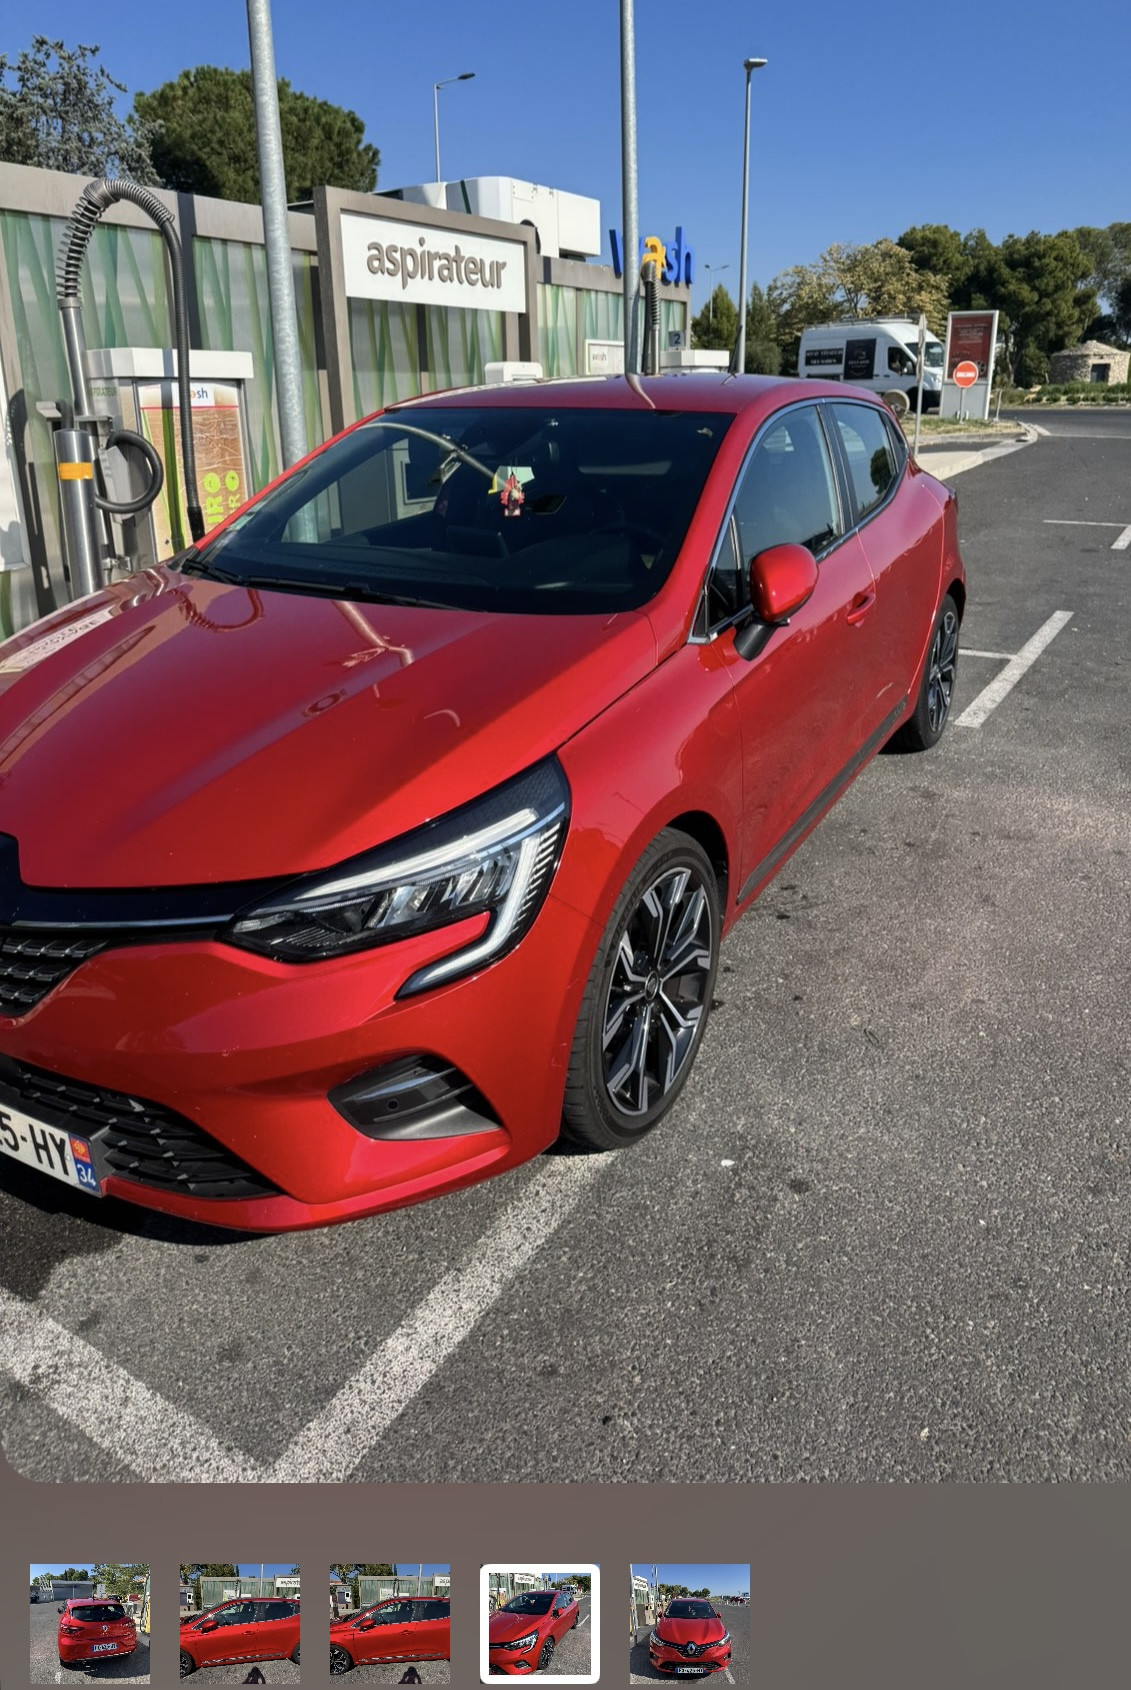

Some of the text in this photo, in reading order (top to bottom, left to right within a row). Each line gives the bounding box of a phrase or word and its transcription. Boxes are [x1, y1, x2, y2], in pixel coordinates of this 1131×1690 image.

[367, 237, 507, 290] aspirateur
[674, 333, 681, 344] 2
[0, 1110, 69, 1176] 5-HY
[77, 1164, 97, 1186] 34
